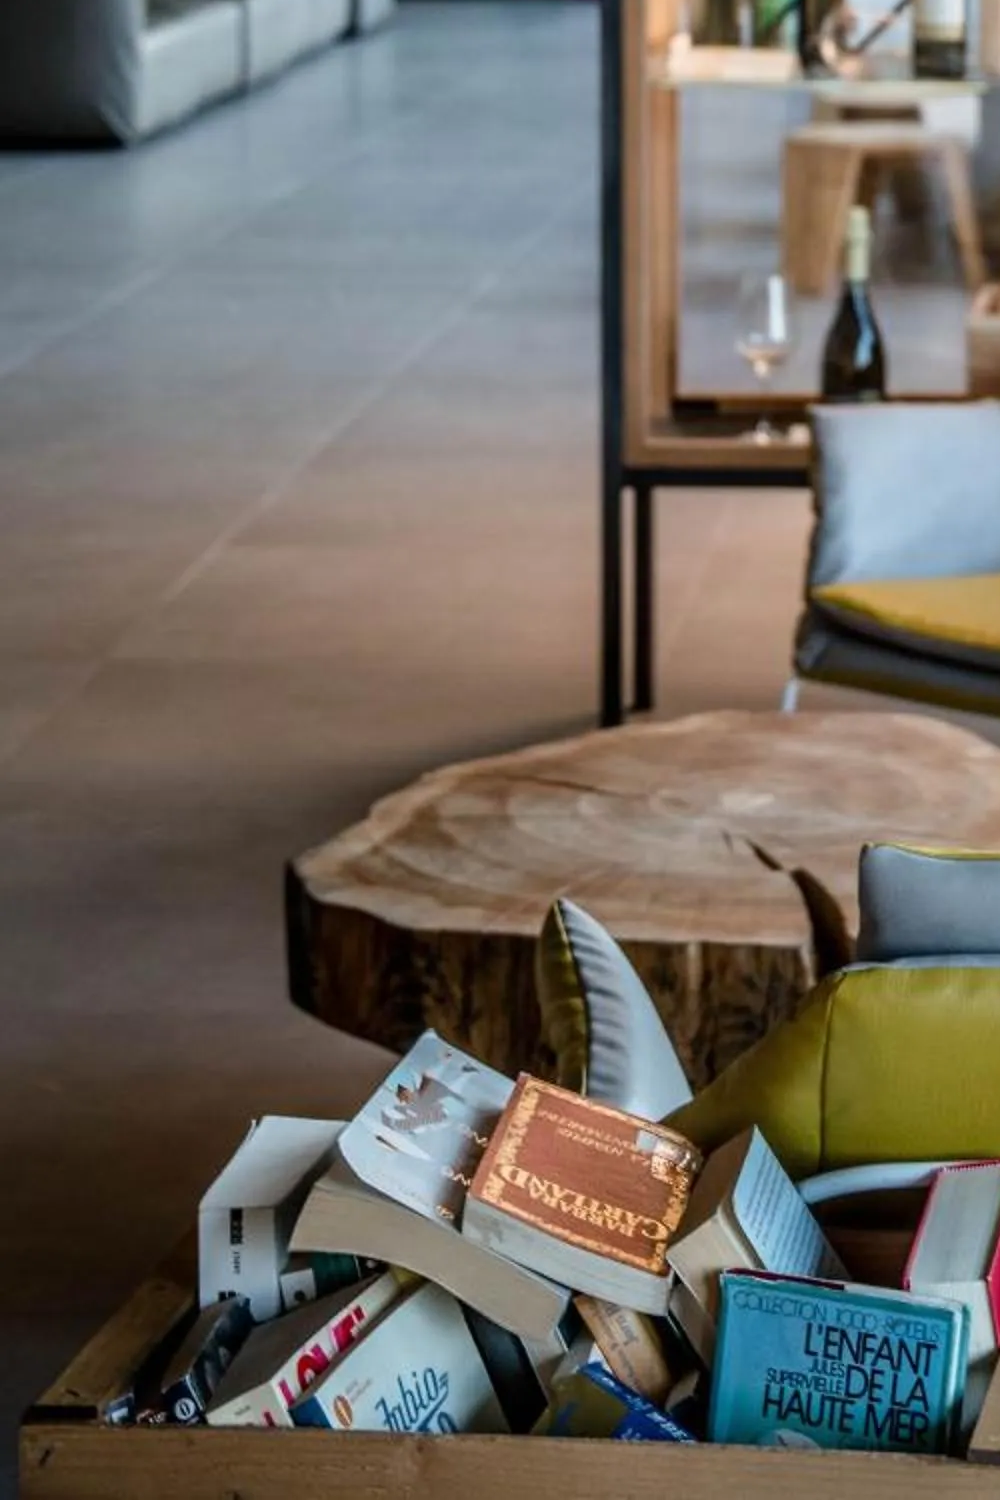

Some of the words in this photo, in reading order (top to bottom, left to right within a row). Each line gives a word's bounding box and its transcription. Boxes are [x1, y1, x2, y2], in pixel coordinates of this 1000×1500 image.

[500, 1163, 669, 1240] CARTLAND
[530, 1183, 635, 1237] BARBARA
[732, 1289, 828, 1322] COLLECTION
[804, 1321, 938, 1377] L'ENFANT
[807, 1358, 845, 1380] JULES
[766, 1366, 845, 1396] SUPERVIELLE
[844, 1363, 885, 1404] DE
[890, 1372, 930, 1412] LA
[762, 1383, 856, 1435] HAUTE
[863, 1402, 930, 1446] MER
